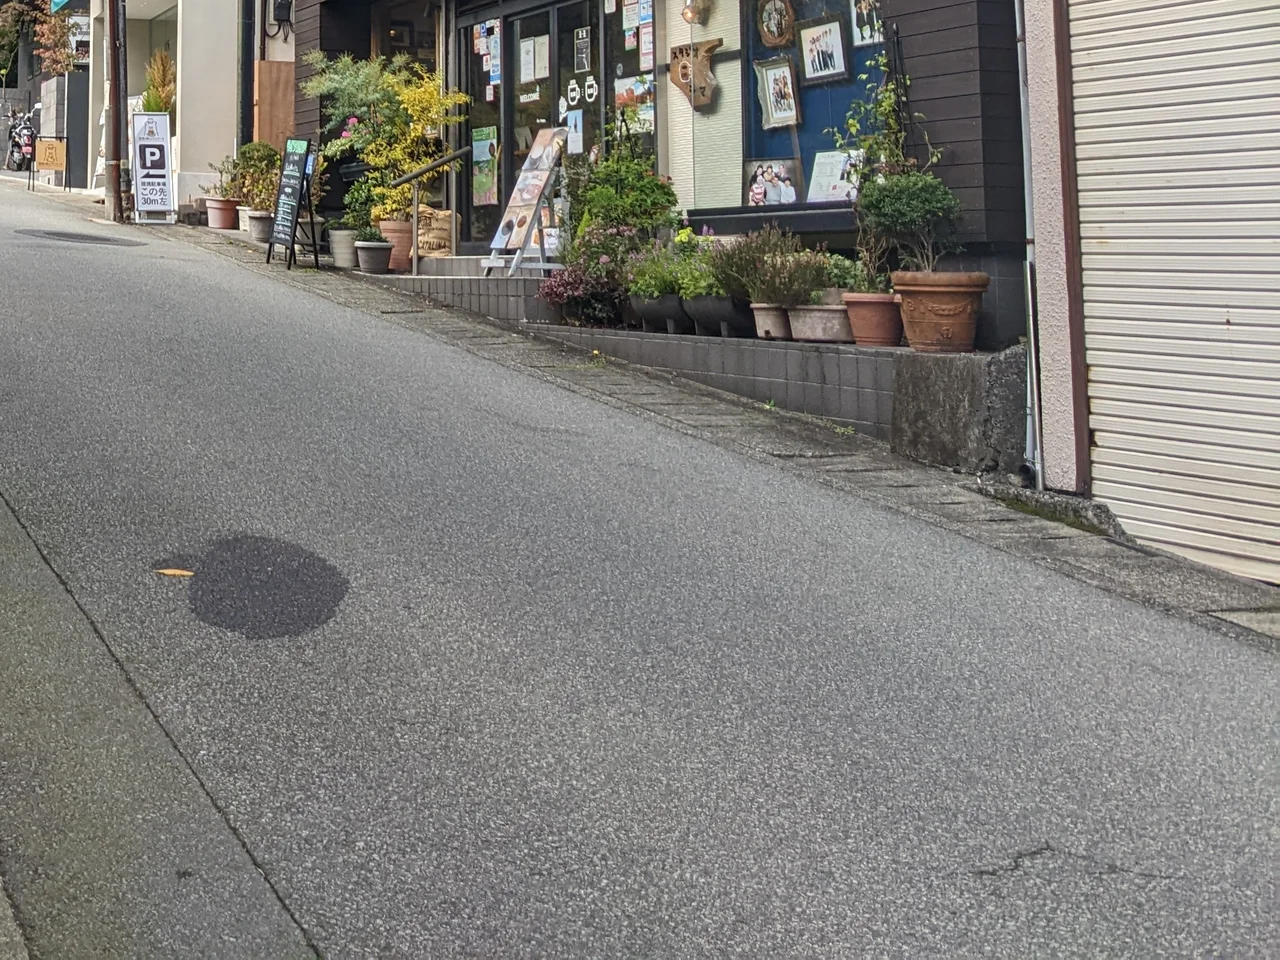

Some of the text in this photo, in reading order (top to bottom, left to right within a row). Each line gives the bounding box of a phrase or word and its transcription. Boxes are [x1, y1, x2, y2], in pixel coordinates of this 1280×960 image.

[145, 147, 160, 167] P
[141, 188, 167, 197] この先
[141, 197, 168, 205] 30m左
